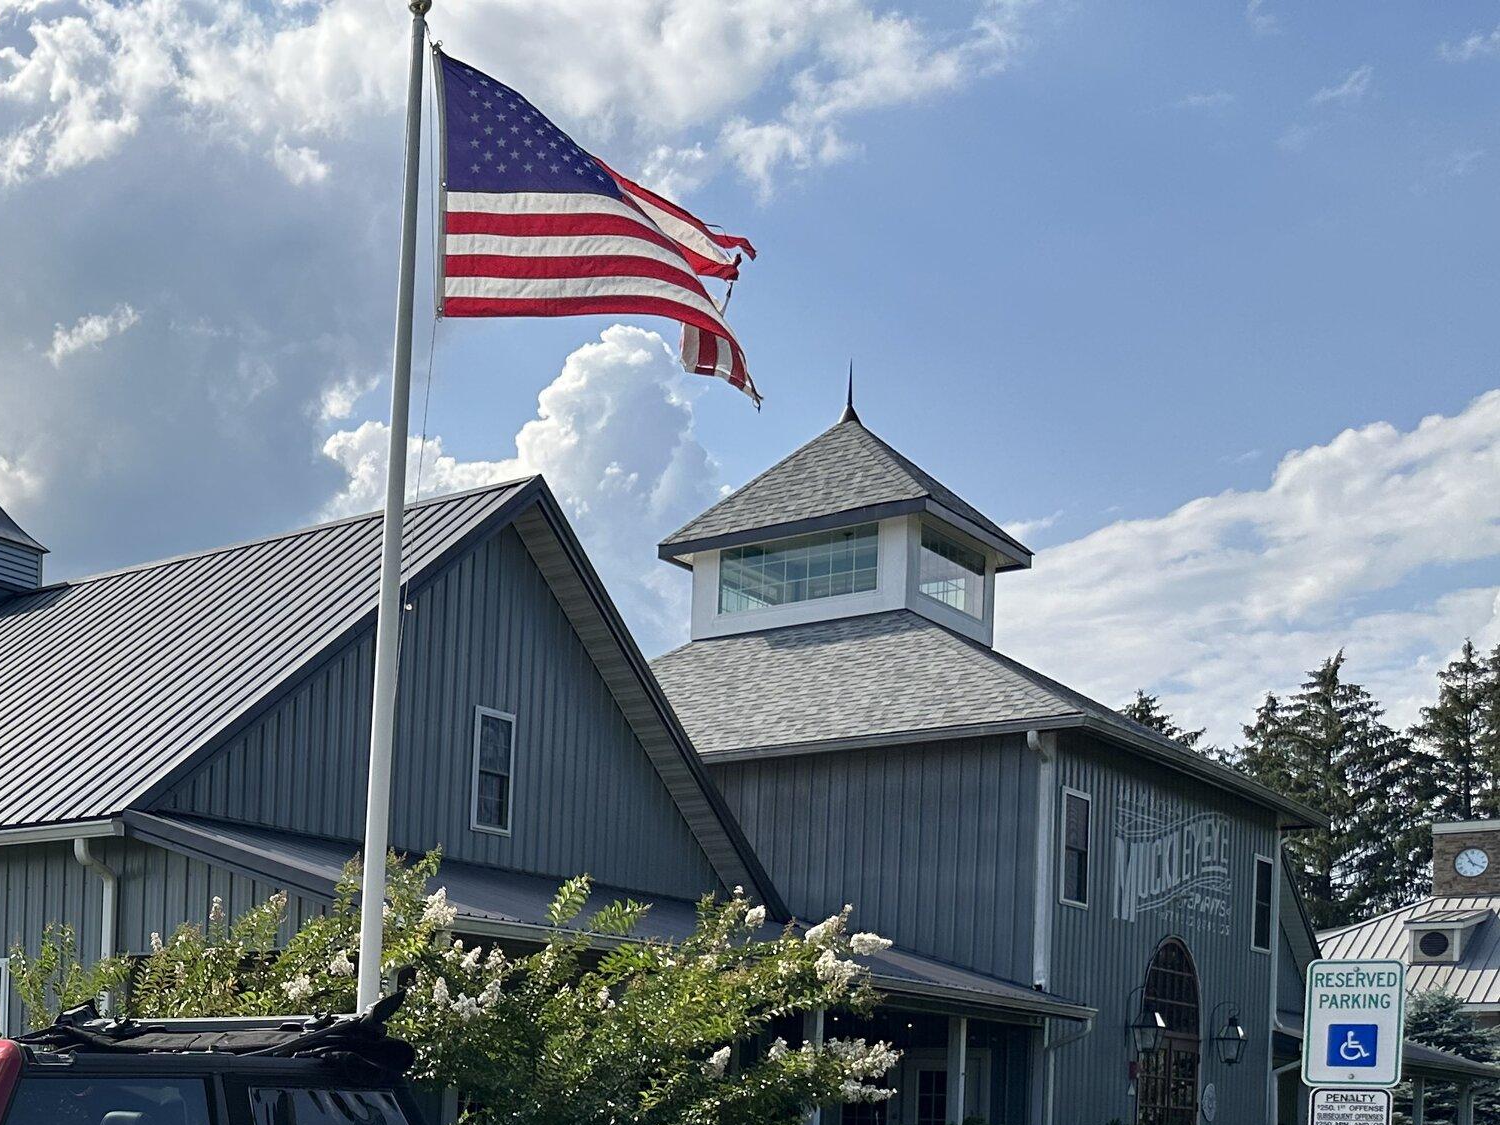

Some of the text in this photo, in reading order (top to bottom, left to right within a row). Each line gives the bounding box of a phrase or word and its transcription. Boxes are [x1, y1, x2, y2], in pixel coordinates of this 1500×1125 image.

[1314, 972, 1398, 988] RESERVED
[1319, 993, 1391, 1009] PARKING
[1326, 1093, 1375, 1102] PENALTY
[1349, 1104, 1384, 1112] OFFENSE
